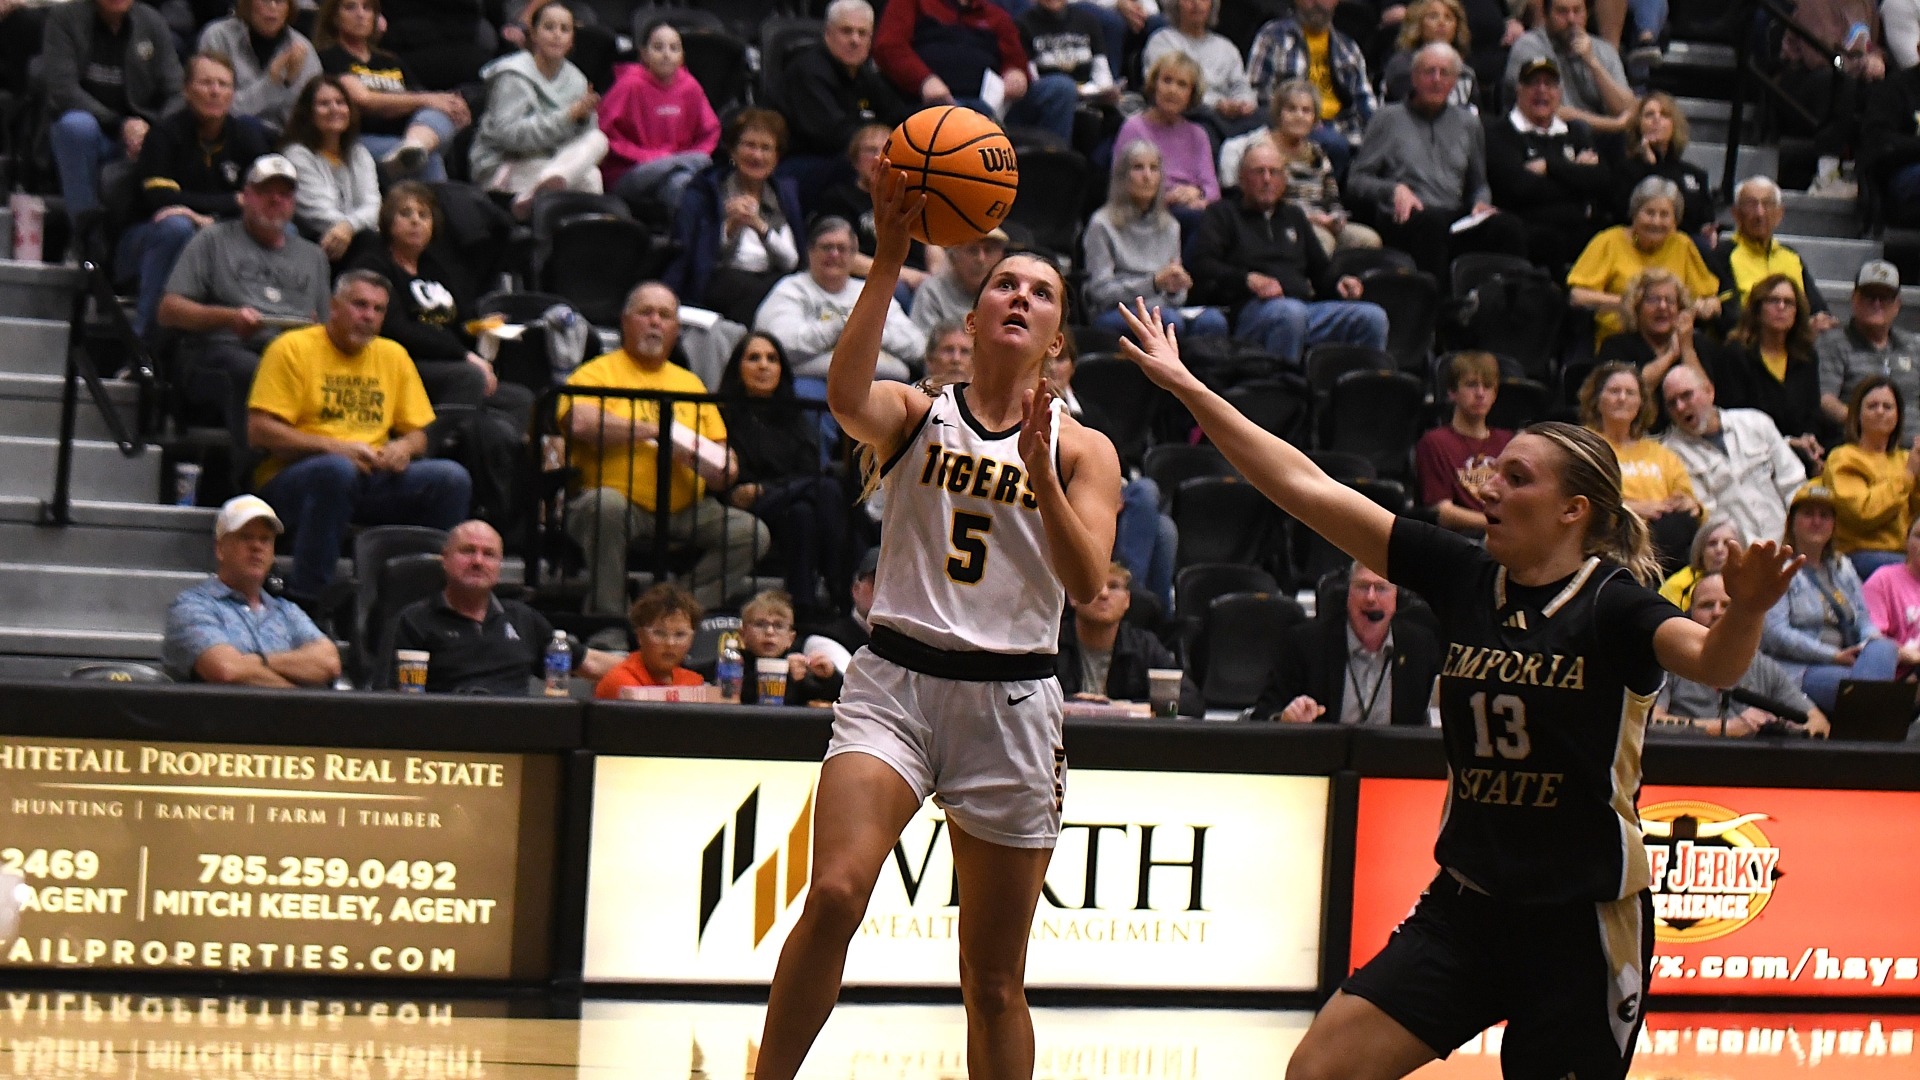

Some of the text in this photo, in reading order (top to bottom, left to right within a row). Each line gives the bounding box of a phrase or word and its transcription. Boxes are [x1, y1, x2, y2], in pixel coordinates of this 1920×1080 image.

[321, 386, 385, 408] TIGER
[943, 508, 993, 587] 5
[701, 616, 742, 631] TIGE
[1442, 642, 1585, 690] EMPORIA
[1469, 691, 1532, 760] 13
[0, 745, 504, 787] HITETAIL PROPERTIES REAL ESTATE
[1458, 768, 1564, 807] STATE
[12, 799, 442, 828] HUNTING RANCH FARM TIMBER
[198, 853, 457, 891] 785.259.0492
[1667, 840, 1780, 894] JERKY
[19, 886, 128, 914] AGENT
[153, 889, 496, 926] MITCH KEELEY, AGENT
[861, 914, 1212, 943] WEALT NAGEMENT
[0, 937, 456, 973] AILPROPERTIES.COM
